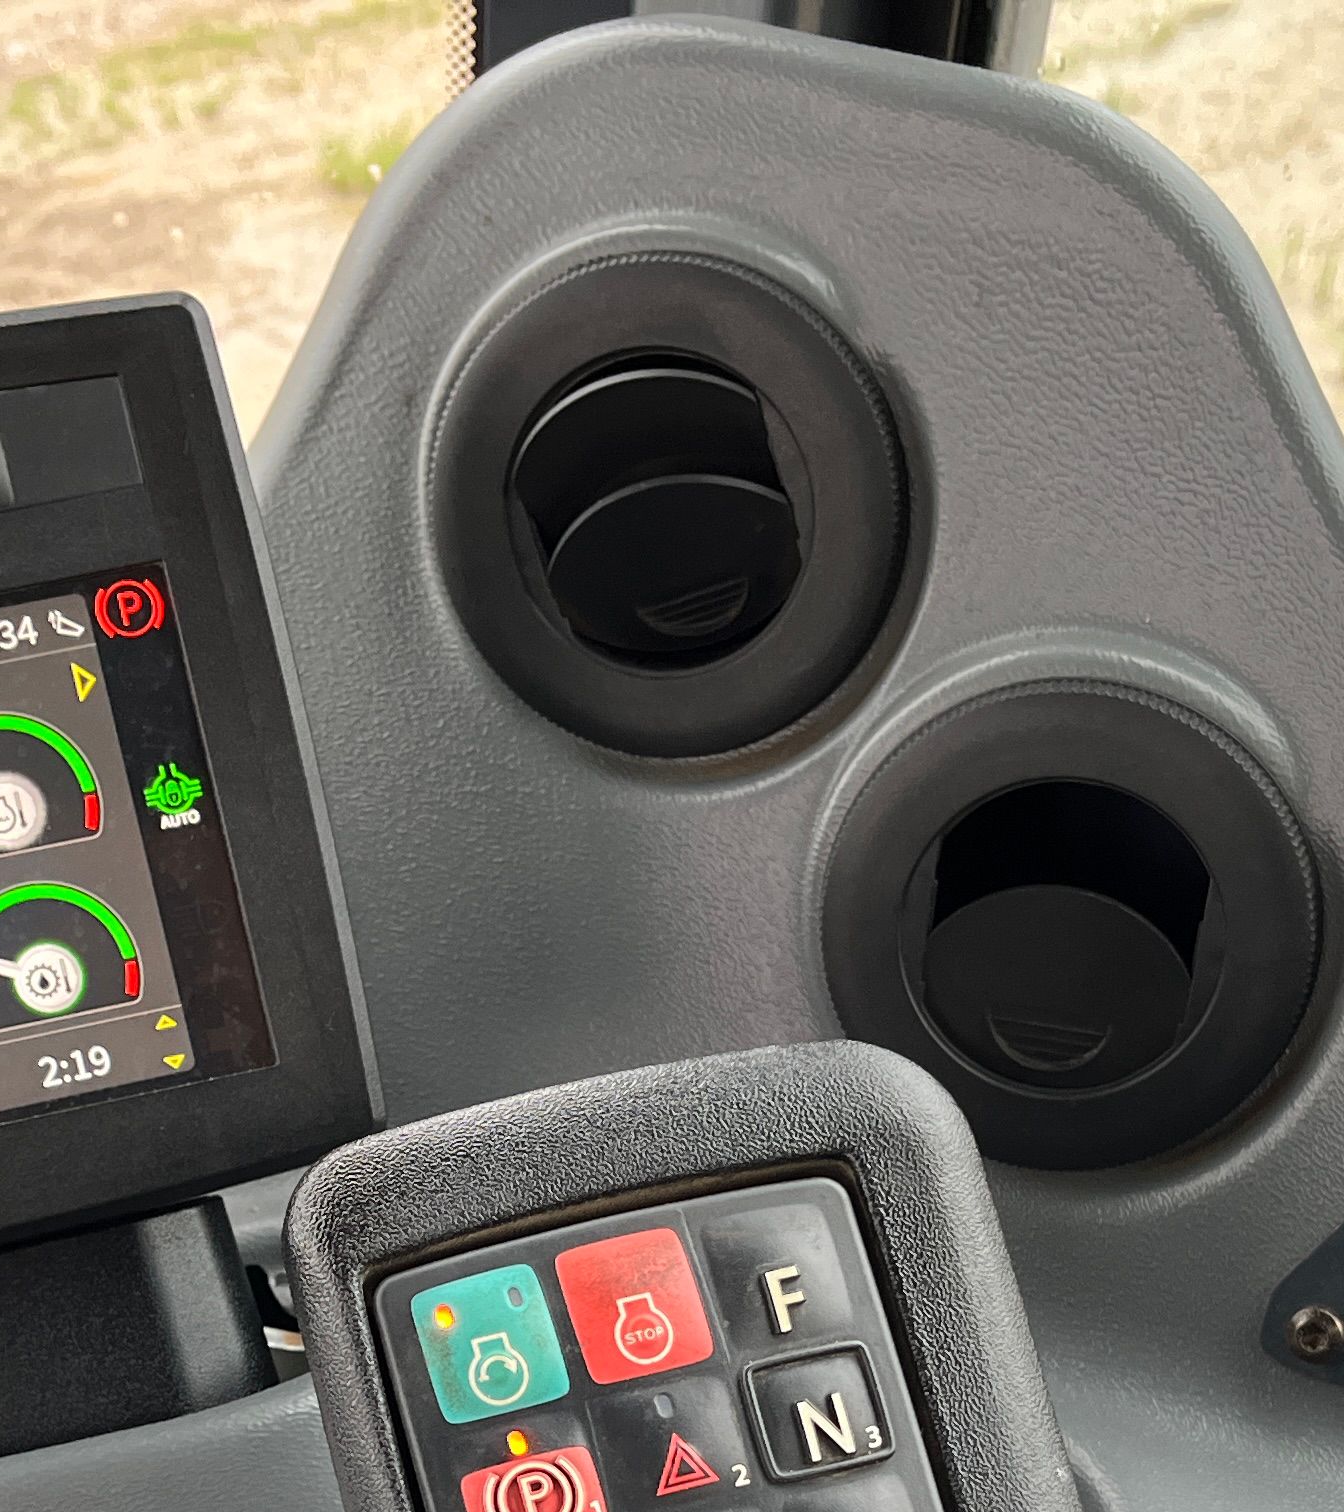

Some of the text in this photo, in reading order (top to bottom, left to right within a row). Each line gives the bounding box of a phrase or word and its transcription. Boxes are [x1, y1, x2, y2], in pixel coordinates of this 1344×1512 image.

[160, 808, 201, 829] AUTO
[37, 1045, 112, 1088] 2:19
[763, 1264, 807, 1334] F
[623, 1325, 665, 1345] STOP
[795, 1392, 857, 1463] N
[864, 1425, 883, 1449] 3
[730, 1463, 751, 1488] 2
